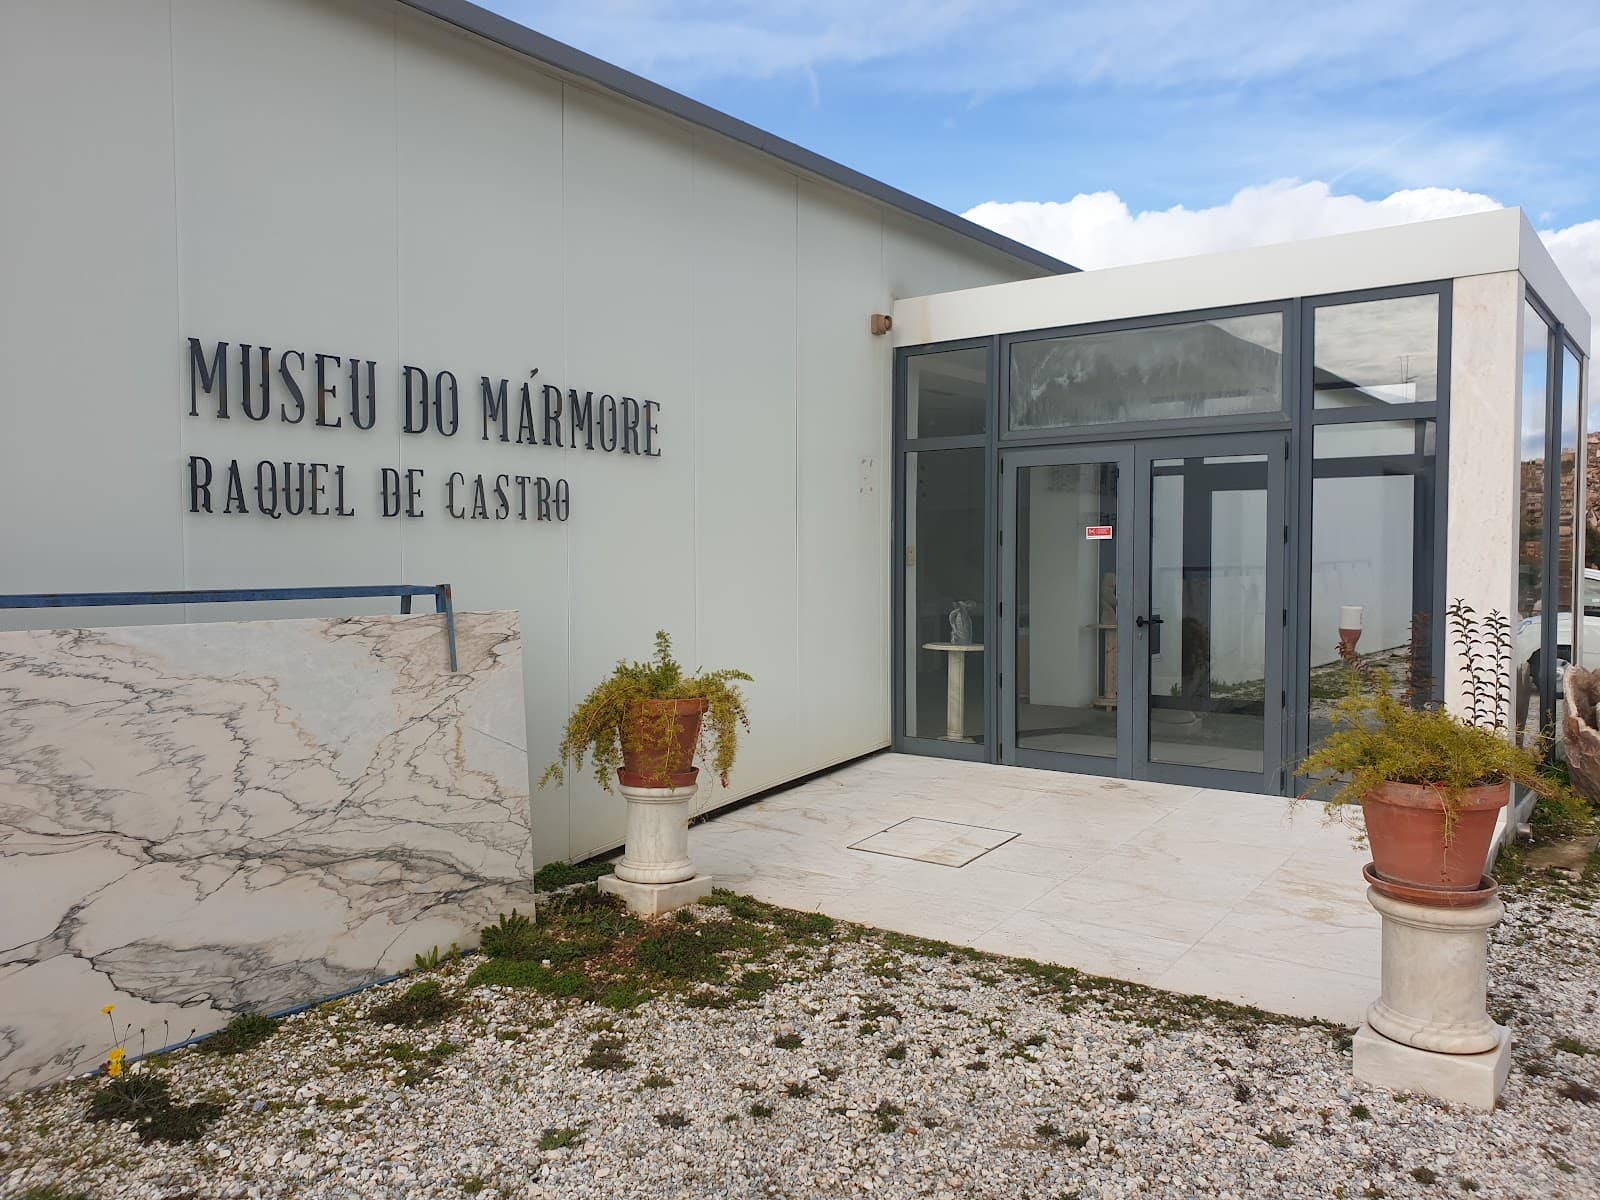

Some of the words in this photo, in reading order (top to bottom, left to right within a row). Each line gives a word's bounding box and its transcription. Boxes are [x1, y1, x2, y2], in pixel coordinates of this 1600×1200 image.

[187, 337, 377, 430] MUSEU
[402, 365, 459, 437] DO
[480, 367, 662, 457] MÁRMORE
[187, 455, 355, 520] RAQUEL
[379, 467, 425, 518] DE
[445, 471, 570, 522] CASTRO
